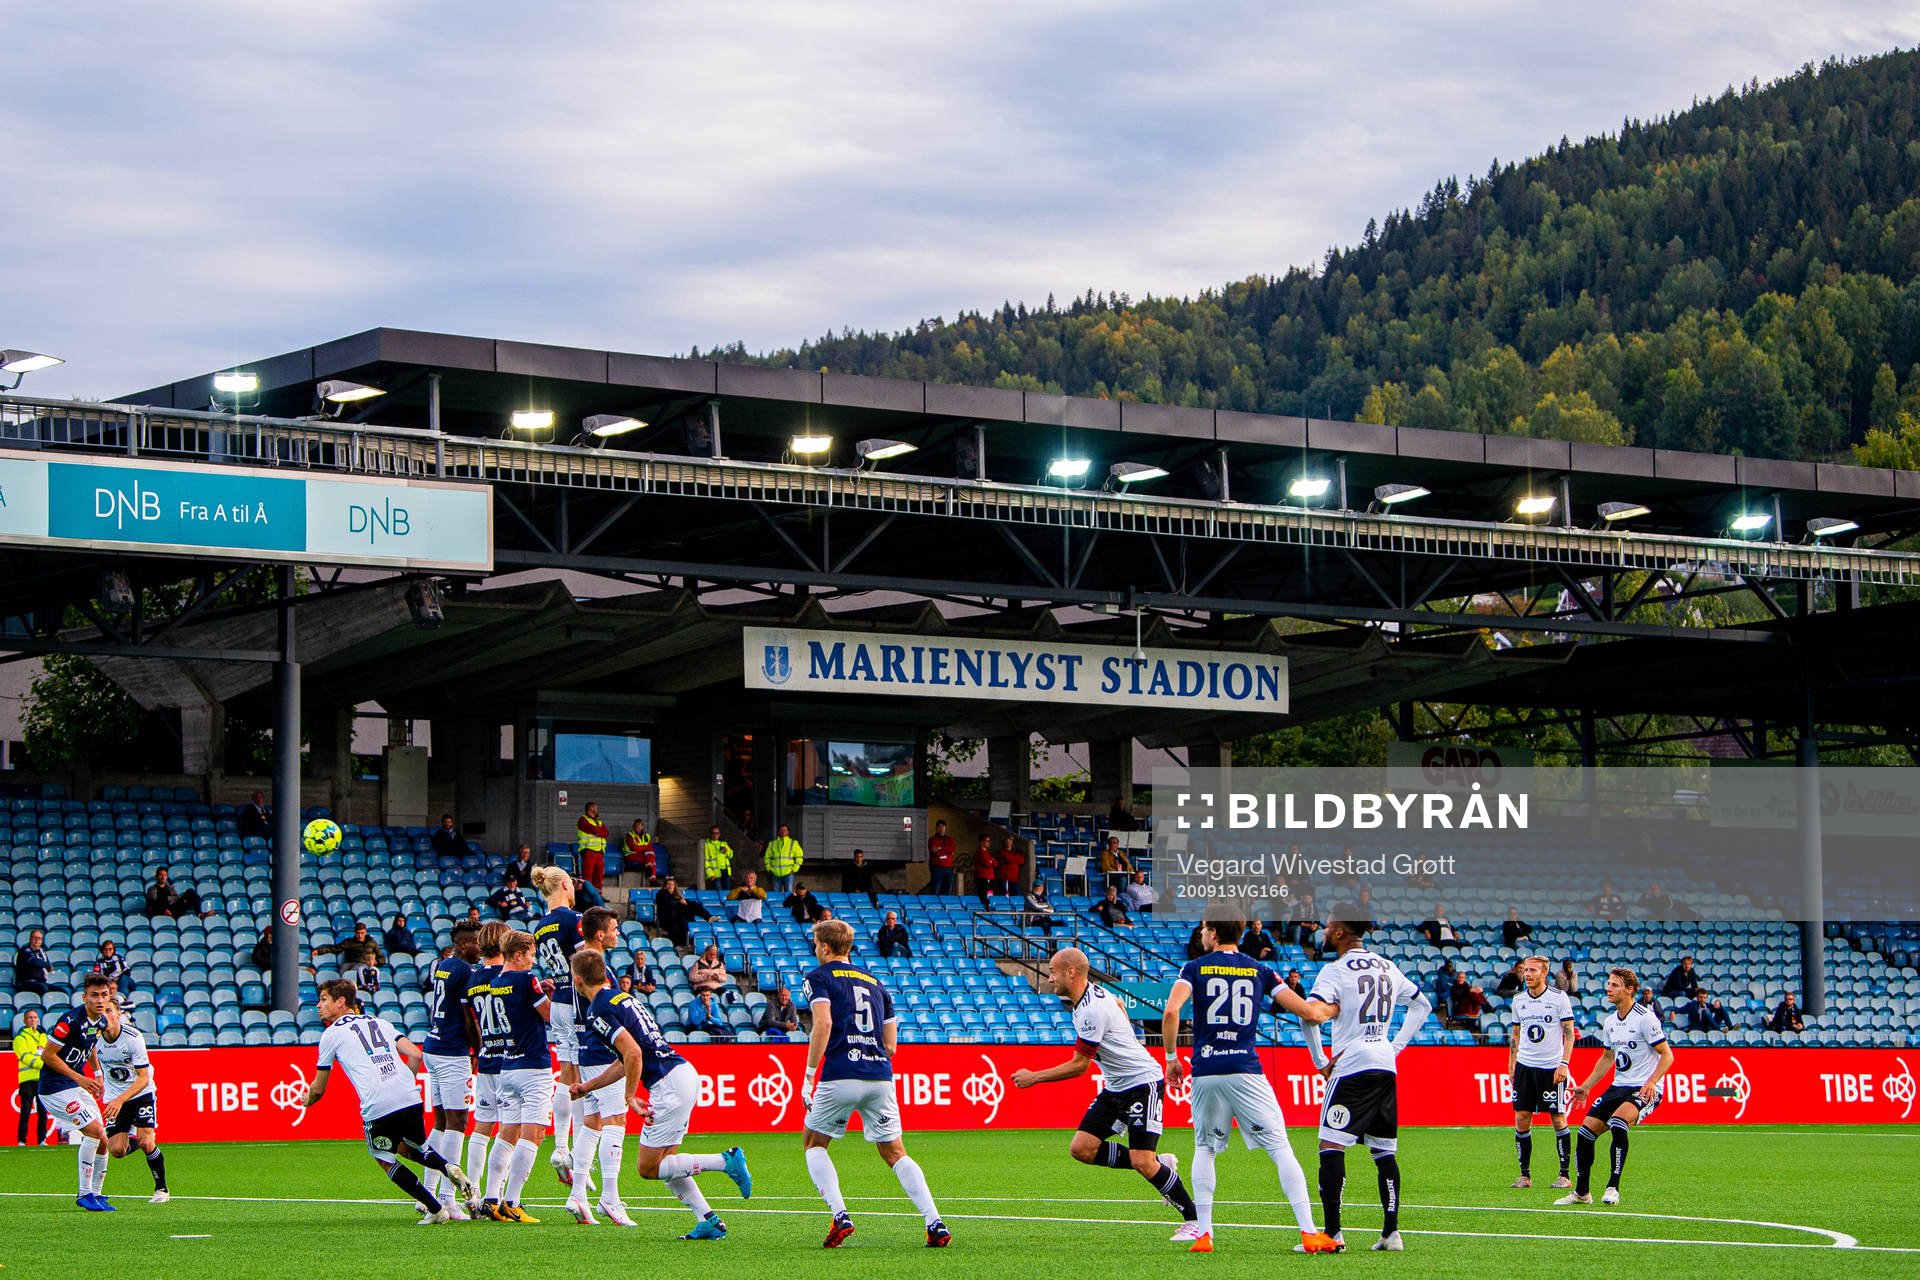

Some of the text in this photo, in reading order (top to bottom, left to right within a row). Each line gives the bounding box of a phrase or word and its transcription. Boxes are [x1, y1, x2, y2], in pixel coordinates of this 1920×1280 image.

[95, 479, 268, 530] DNB Fra A til Å
[349, 496, 410, 545] DNB
[807, 640, 1280, 702] MARIENLYST STADION
[1421, 746, 1503, 790] GARO
[1777, 806, 1798, 819] brav
[1200, 965, 1258, 978] BETONMAST
[852, 985, 874, 1033] 5
[1206, 977, 1254, 1026] 26
[1357, 974, 1393, 1024] 28
[349, 1020, 391, 1056] 14
[65, 1042, 95, 1070] DN
[380, 1062, 397, 1076] MOT
[191, 1081, 259, 1112] TIBE
[696, 1074, 736, 1107] BE
[1287, 1074, 1327, 1106] TIB
[1474, 1073, 1513, 1104] TIB
[1666, 1073, 1707, 1103] IBE
[1820, 1073, 1874, 1103] TIBE
[79, 1109, 92, 1122] 14
